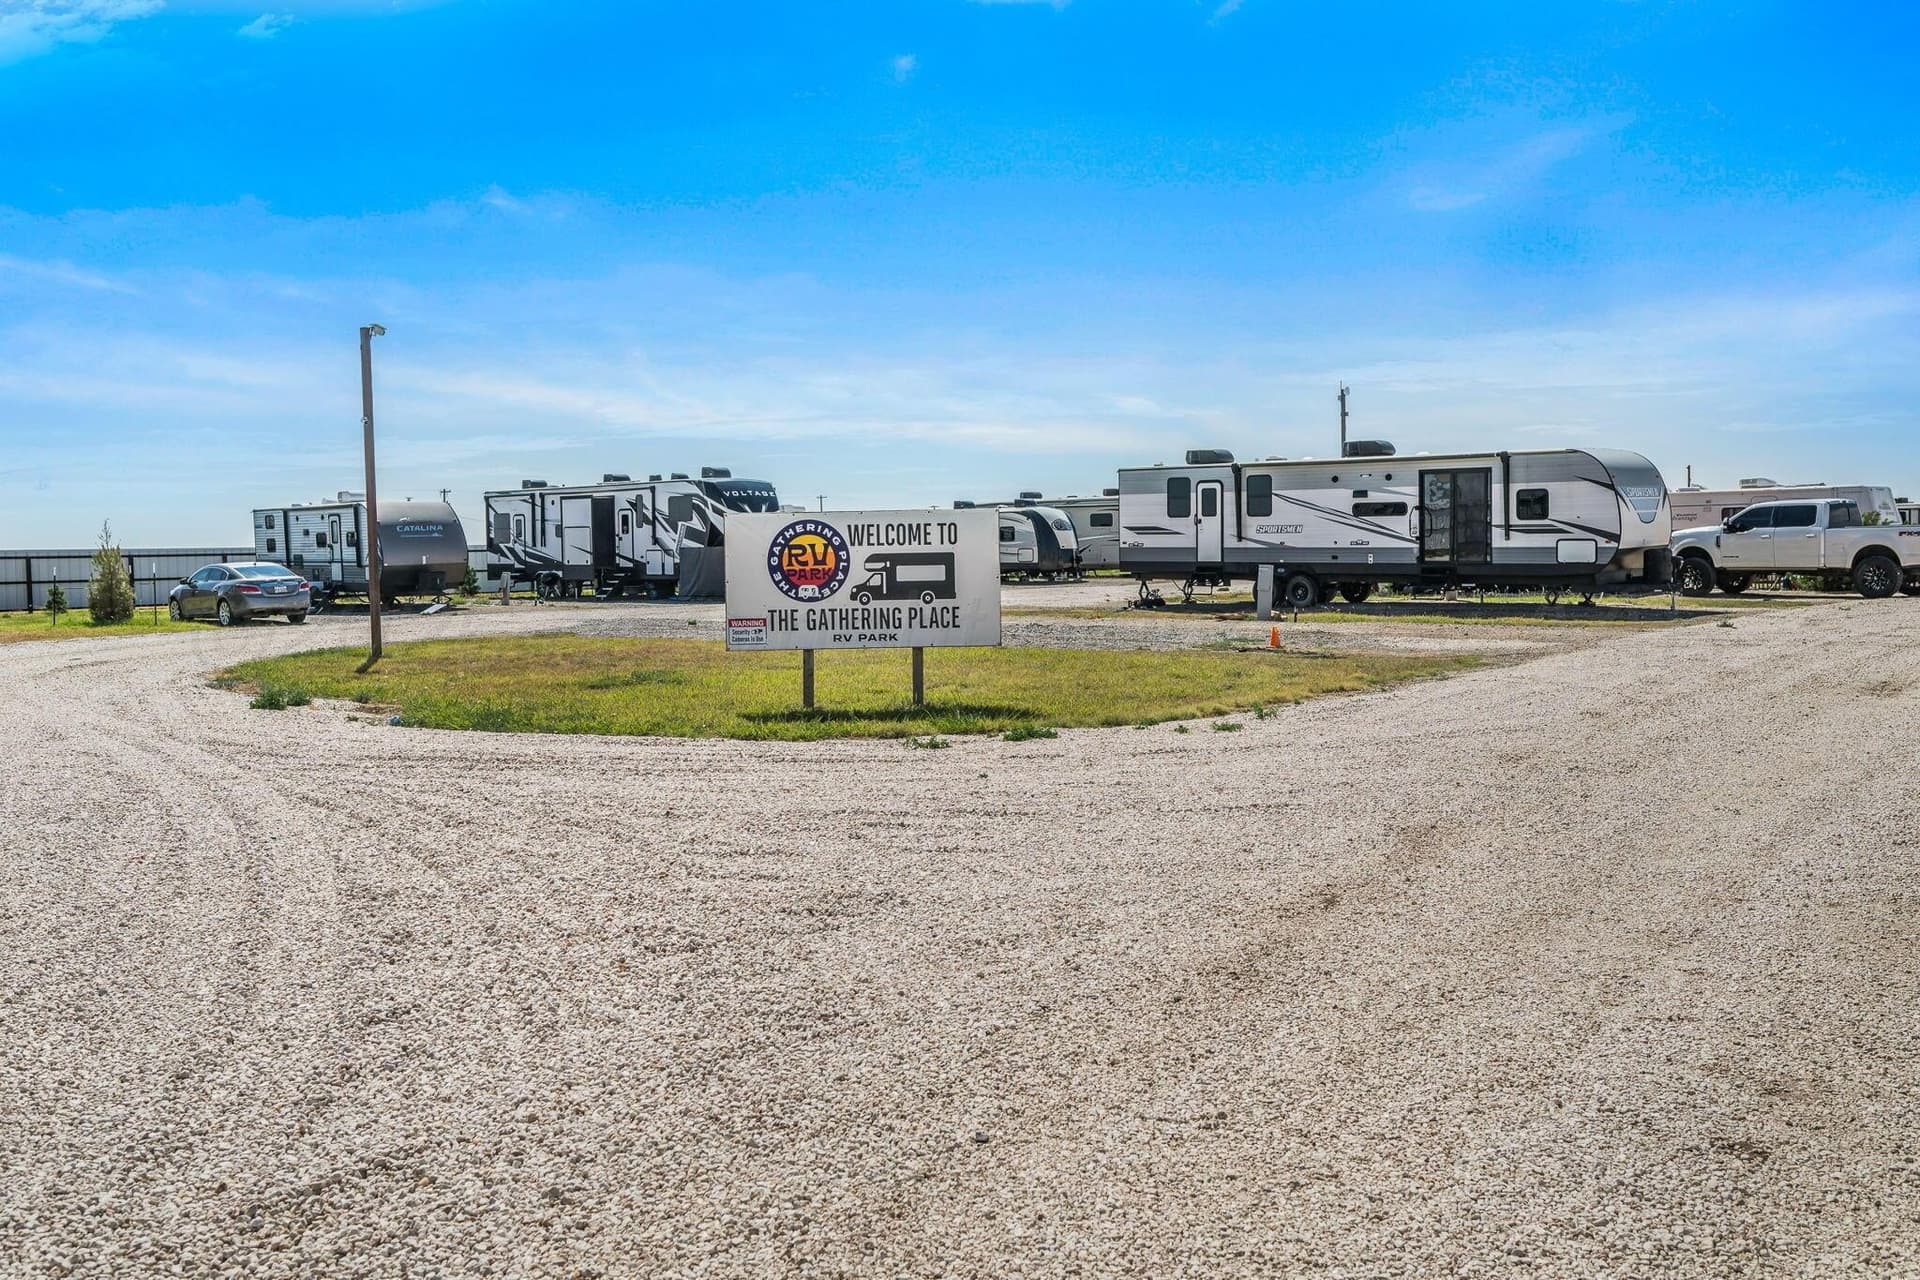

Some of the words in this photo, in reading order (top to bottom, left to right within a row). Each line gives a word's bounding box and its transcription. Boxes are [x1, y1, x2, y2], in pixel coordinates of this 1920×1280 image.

[396, 524, 443, 532] CATALINA
[847, 523, 932, 546] WELCOME
[936, 522, 957, 545] TO
[1256, 525, 1303, 534] SPORTSMEN
[770, 523, 841, 566] GATHERING
[786, 543, 830, 567] RV
[773, 571, 796, 598] THE
[785, 567, 833, 580] PARK
[821, 551, 848, 598] PLACE
[768, 609, 799, 631] THE
[806, 607, 902, 631] GATHERING
[908, 606, 961, 630] PLACE
[833, 634, 853, 642] RV
[858, 633, 899, 642] PARK
